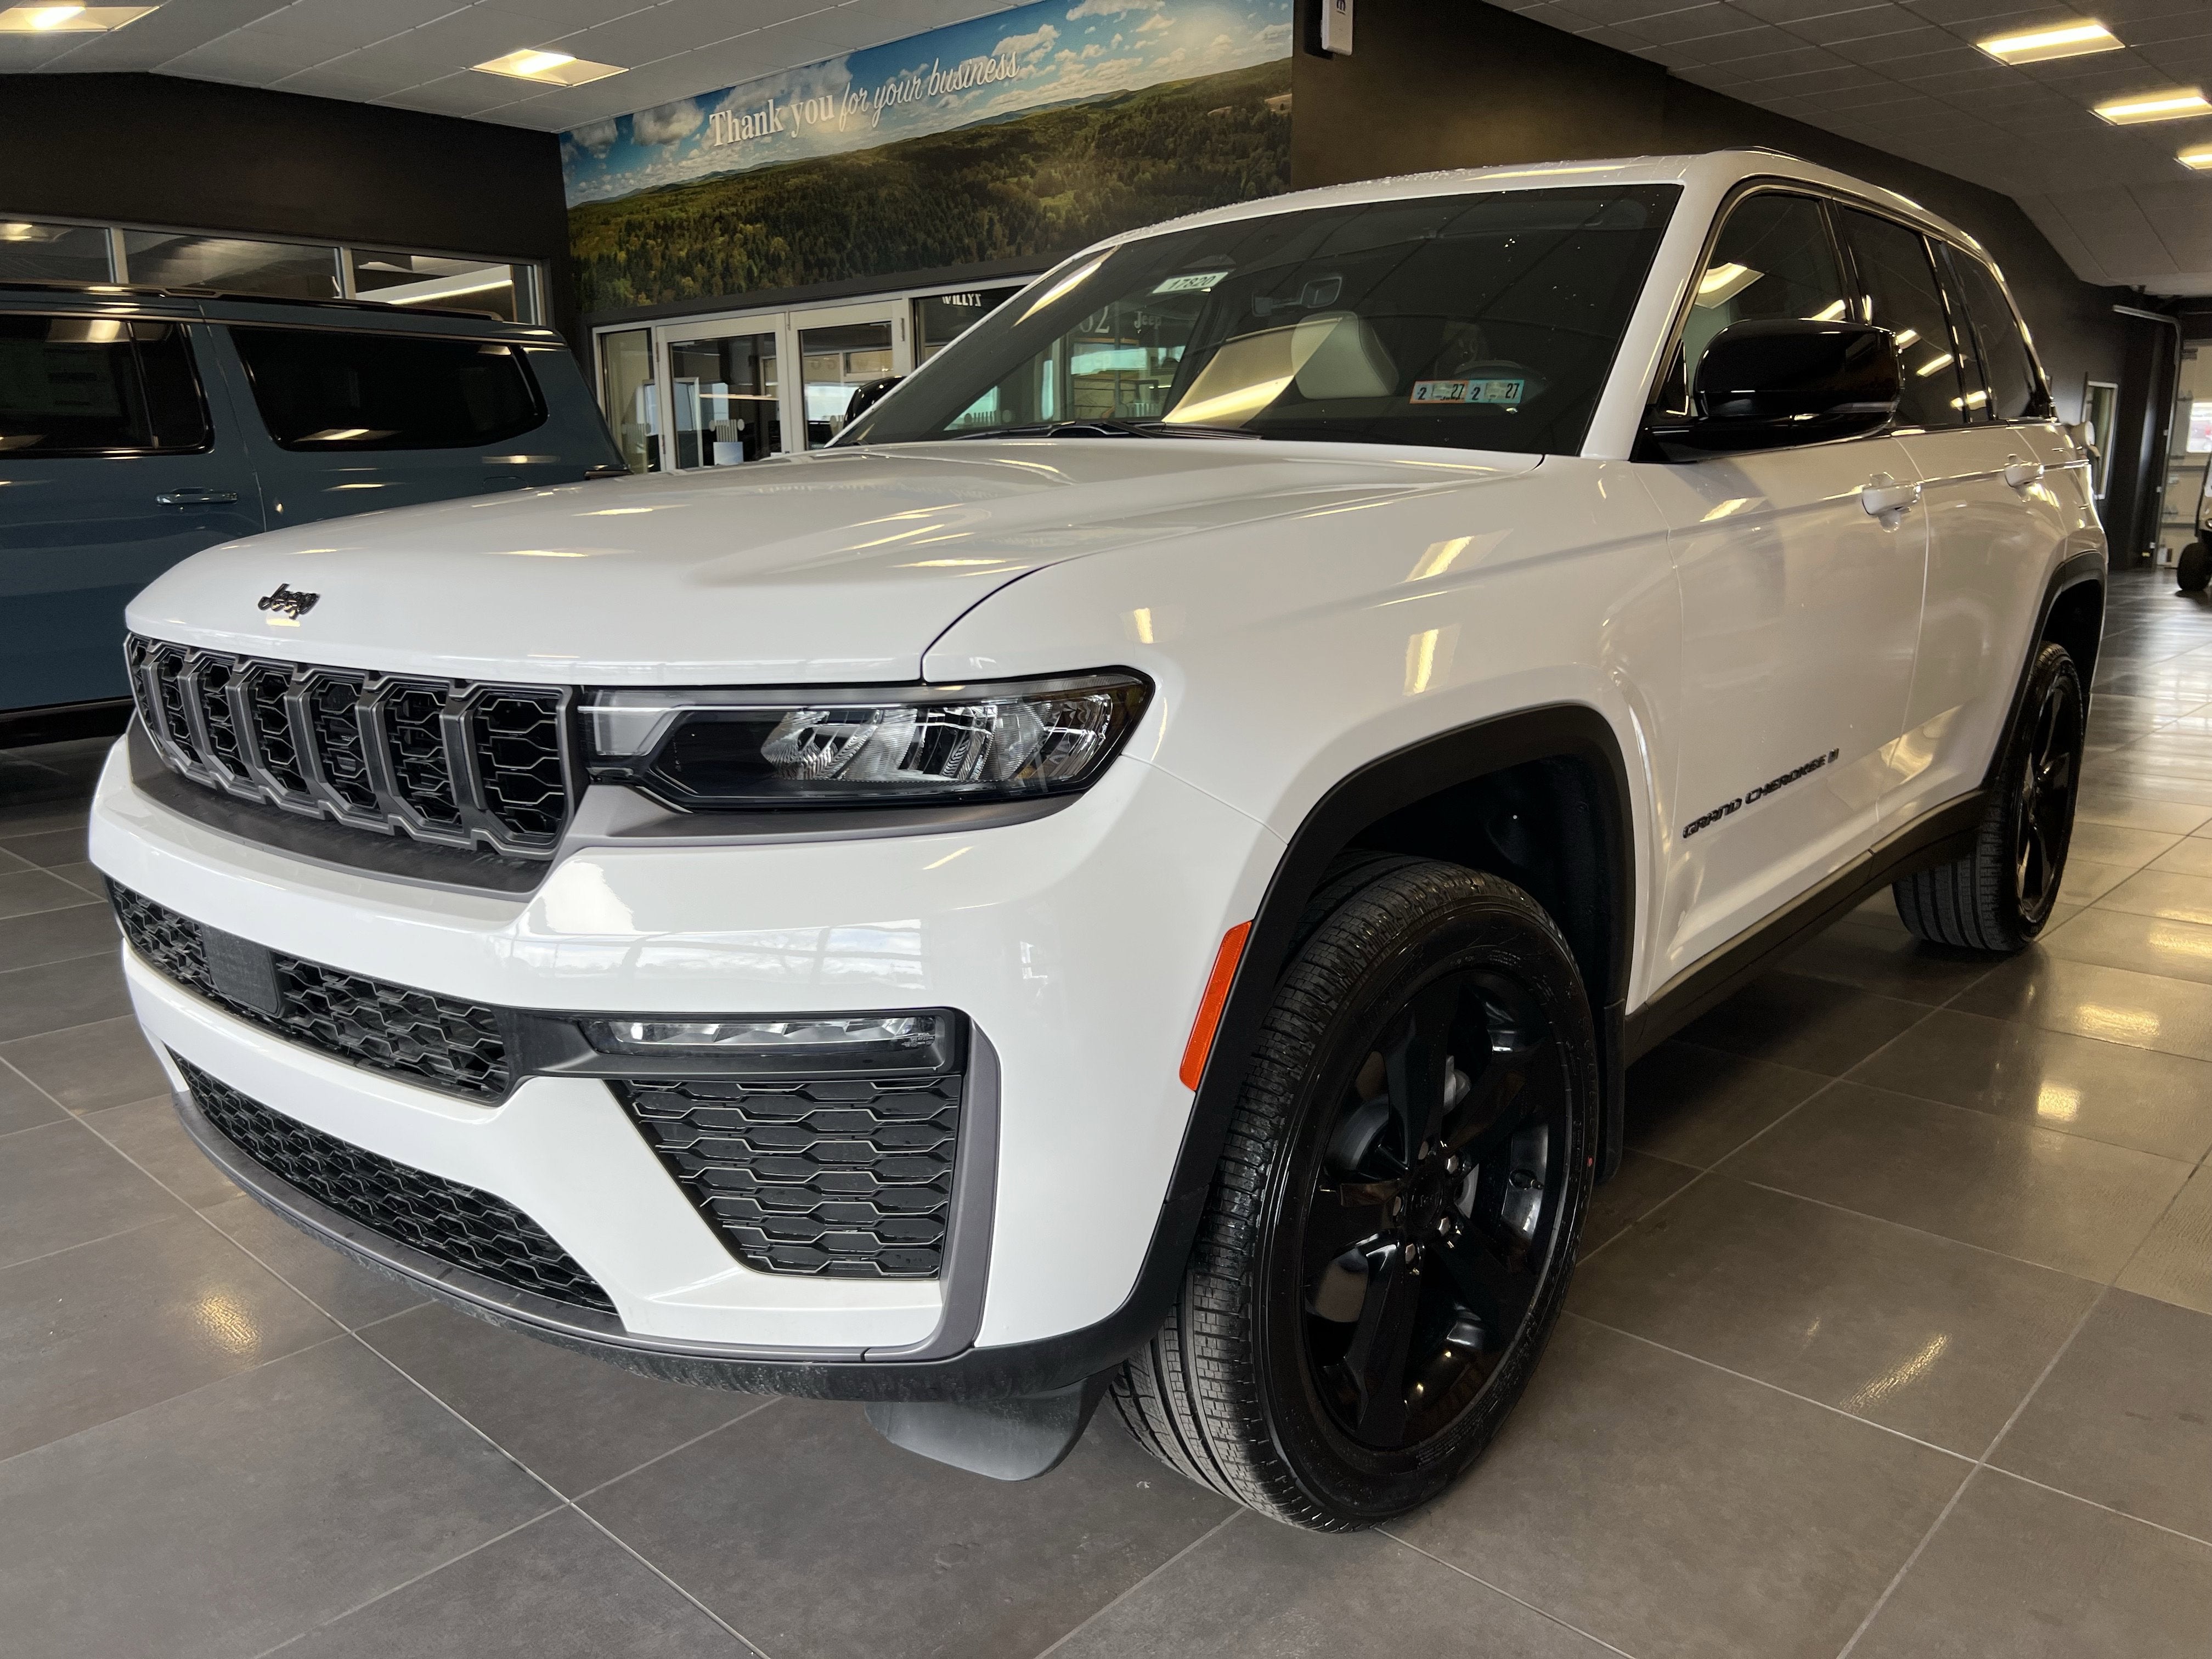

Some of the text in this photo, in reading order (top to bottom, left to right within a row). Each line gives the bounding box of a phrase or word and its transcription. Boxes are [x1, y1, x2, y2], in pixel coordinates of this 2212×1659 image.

[709, 51, 1020, 147] Thank you for your business
[1167, 275, 1216, 291] 17820
[1133, 311, 1162, 330] Jeep
[1417, 383, 1465, 400] 2 27
[1471, 383, 1520, 400] 2 27
[258, 583, 321, 620] Jeep
[1682, 753, 1826, 839] GRAND CHEROKEE
